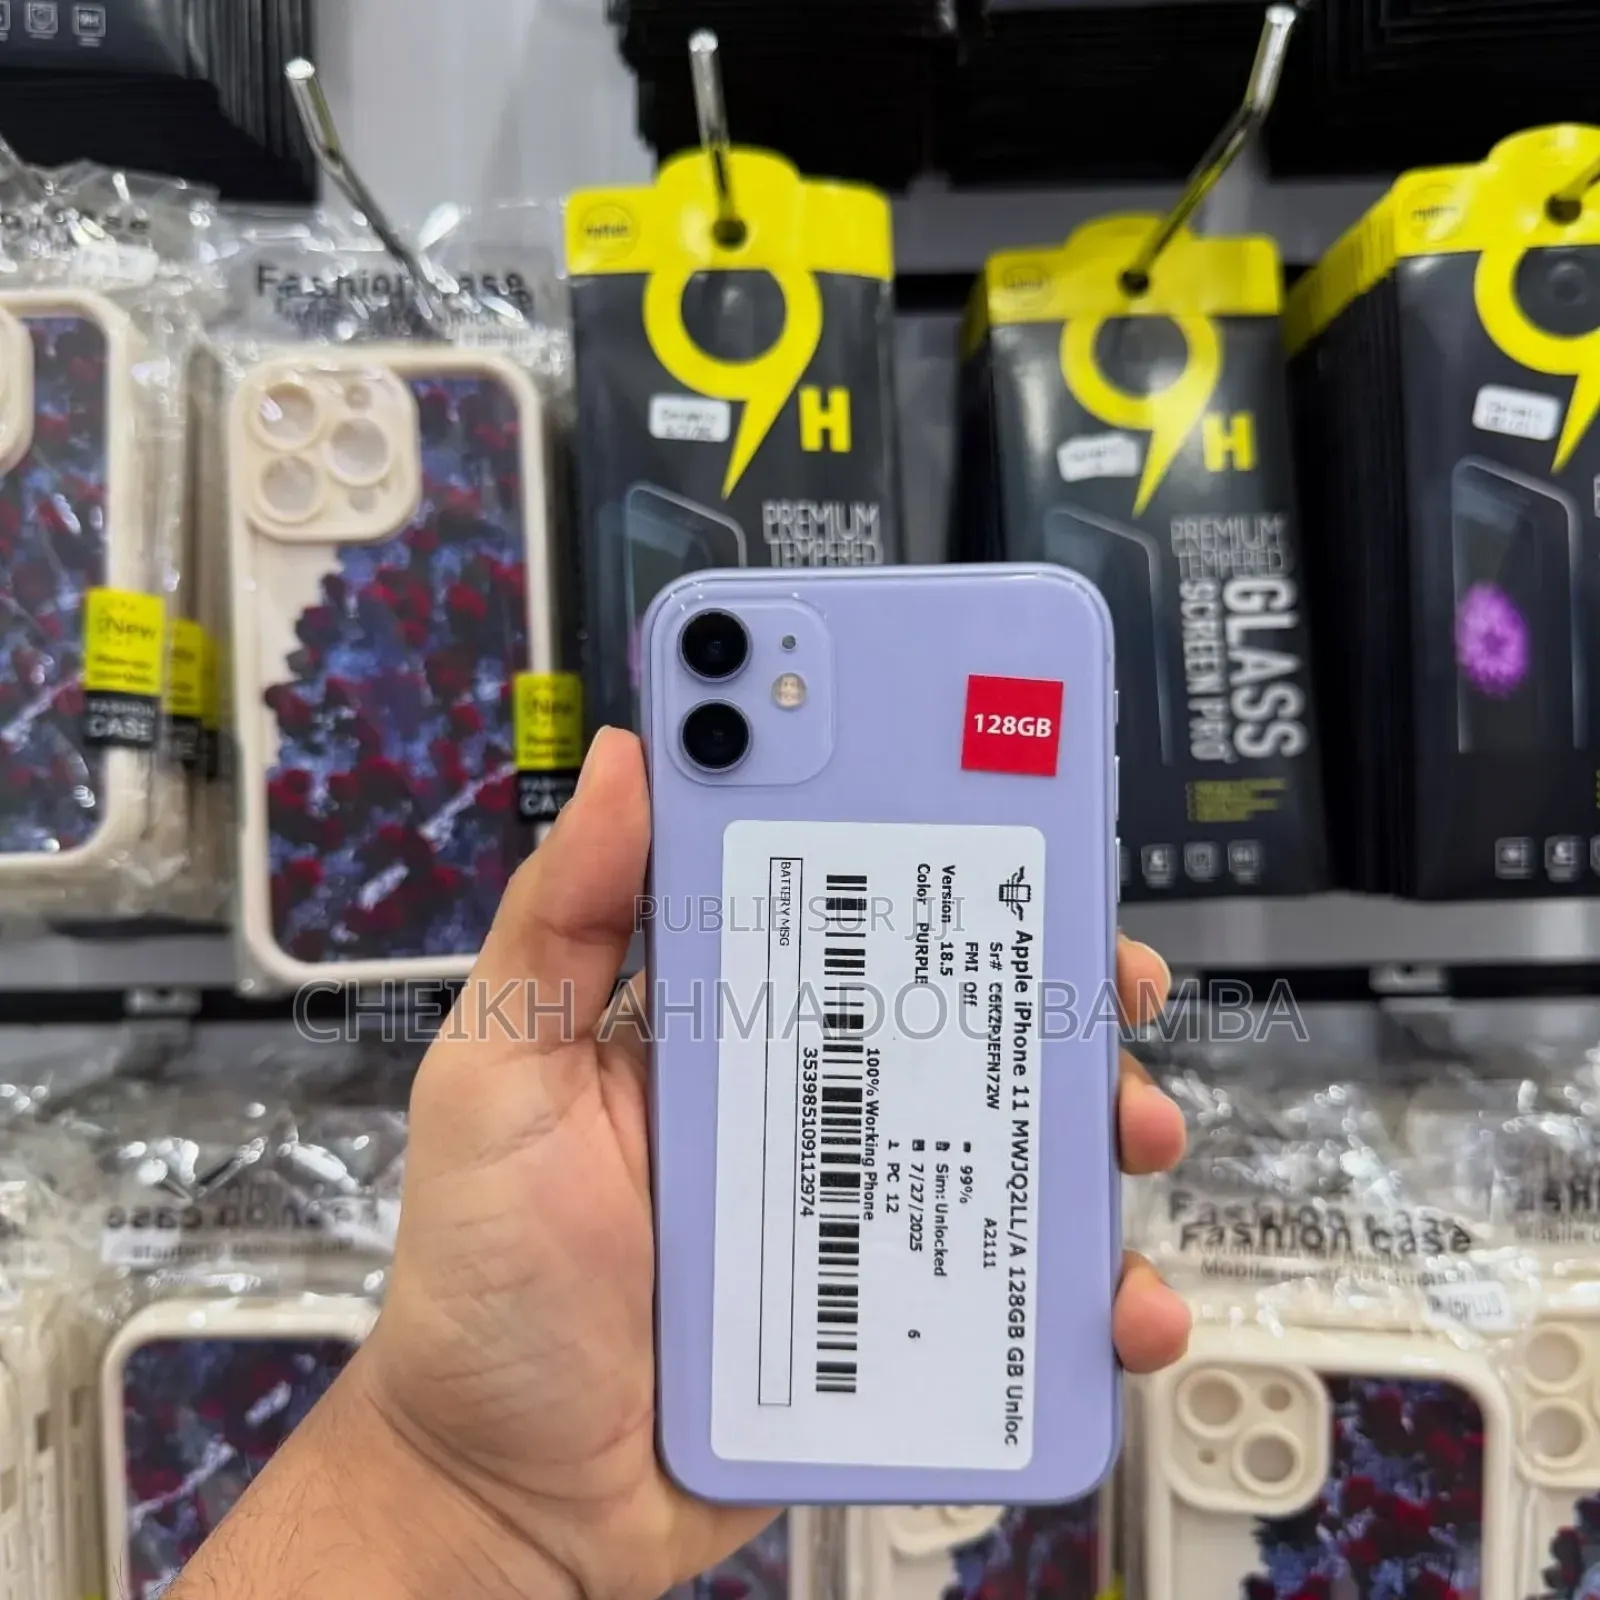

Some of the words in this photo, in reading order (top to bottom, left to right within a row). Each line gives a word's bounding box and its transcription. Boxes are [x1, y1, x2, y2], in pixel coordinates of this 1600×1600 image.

[761, 499, 880, 541] PREMIUM
[1171, 514, 1285, 553] PREMIUM
[1179, 578, 1225, 695] SCREEN
[1222, 575, 1306, 758] GLASS
[89, 701, 156, 718] FASHION
[89, 715, 153, 741] CASE
[973, 713, 1052, 738] 128GB
[780, 861, 792, 916] BATTERY
[916, 863, 931, 905] Color
[941, 864, 956, 924] Version
[779, 918, 790, 946] MSG
[915, 922, 929, 984] PURPLE
[939, 941, 954, 976] 18.5
[965, 941, 978, 972] FMI
[989, 941, 1003, 971] Sr#
[1011, 930, 1033, 993] Apple
[963, 981, 978, 1007] Off
[1012, 1001, 1032, 1076] iPhone
[866, 1048, 880, 1097] 100%
[1012, 1085, 1030, 1110] 11
[800, 1047, 818, 1217] 353985109112974
[861, 1100, 879, 1167] Working
[886, 1162, 901, 1183] PC
[959, 1165, 973, 1204] 99%
[1007, 1119, 1029, 1257] MWJQ2LL/A
[863, 1171, 878, 1221] Phone
[886, 1193, 900, 1213] 12
[908, 1163, 925, 1252] 7/27/2025
[983, 1217, 998, 1269] A2111
[1007, 1266, 1026, 1339] 128GB
[907, 1329, 921, 1340] 6
[1006, 1347, 1025, 1378] GB
[1004, 1385, 1023, 1446] Unloc
